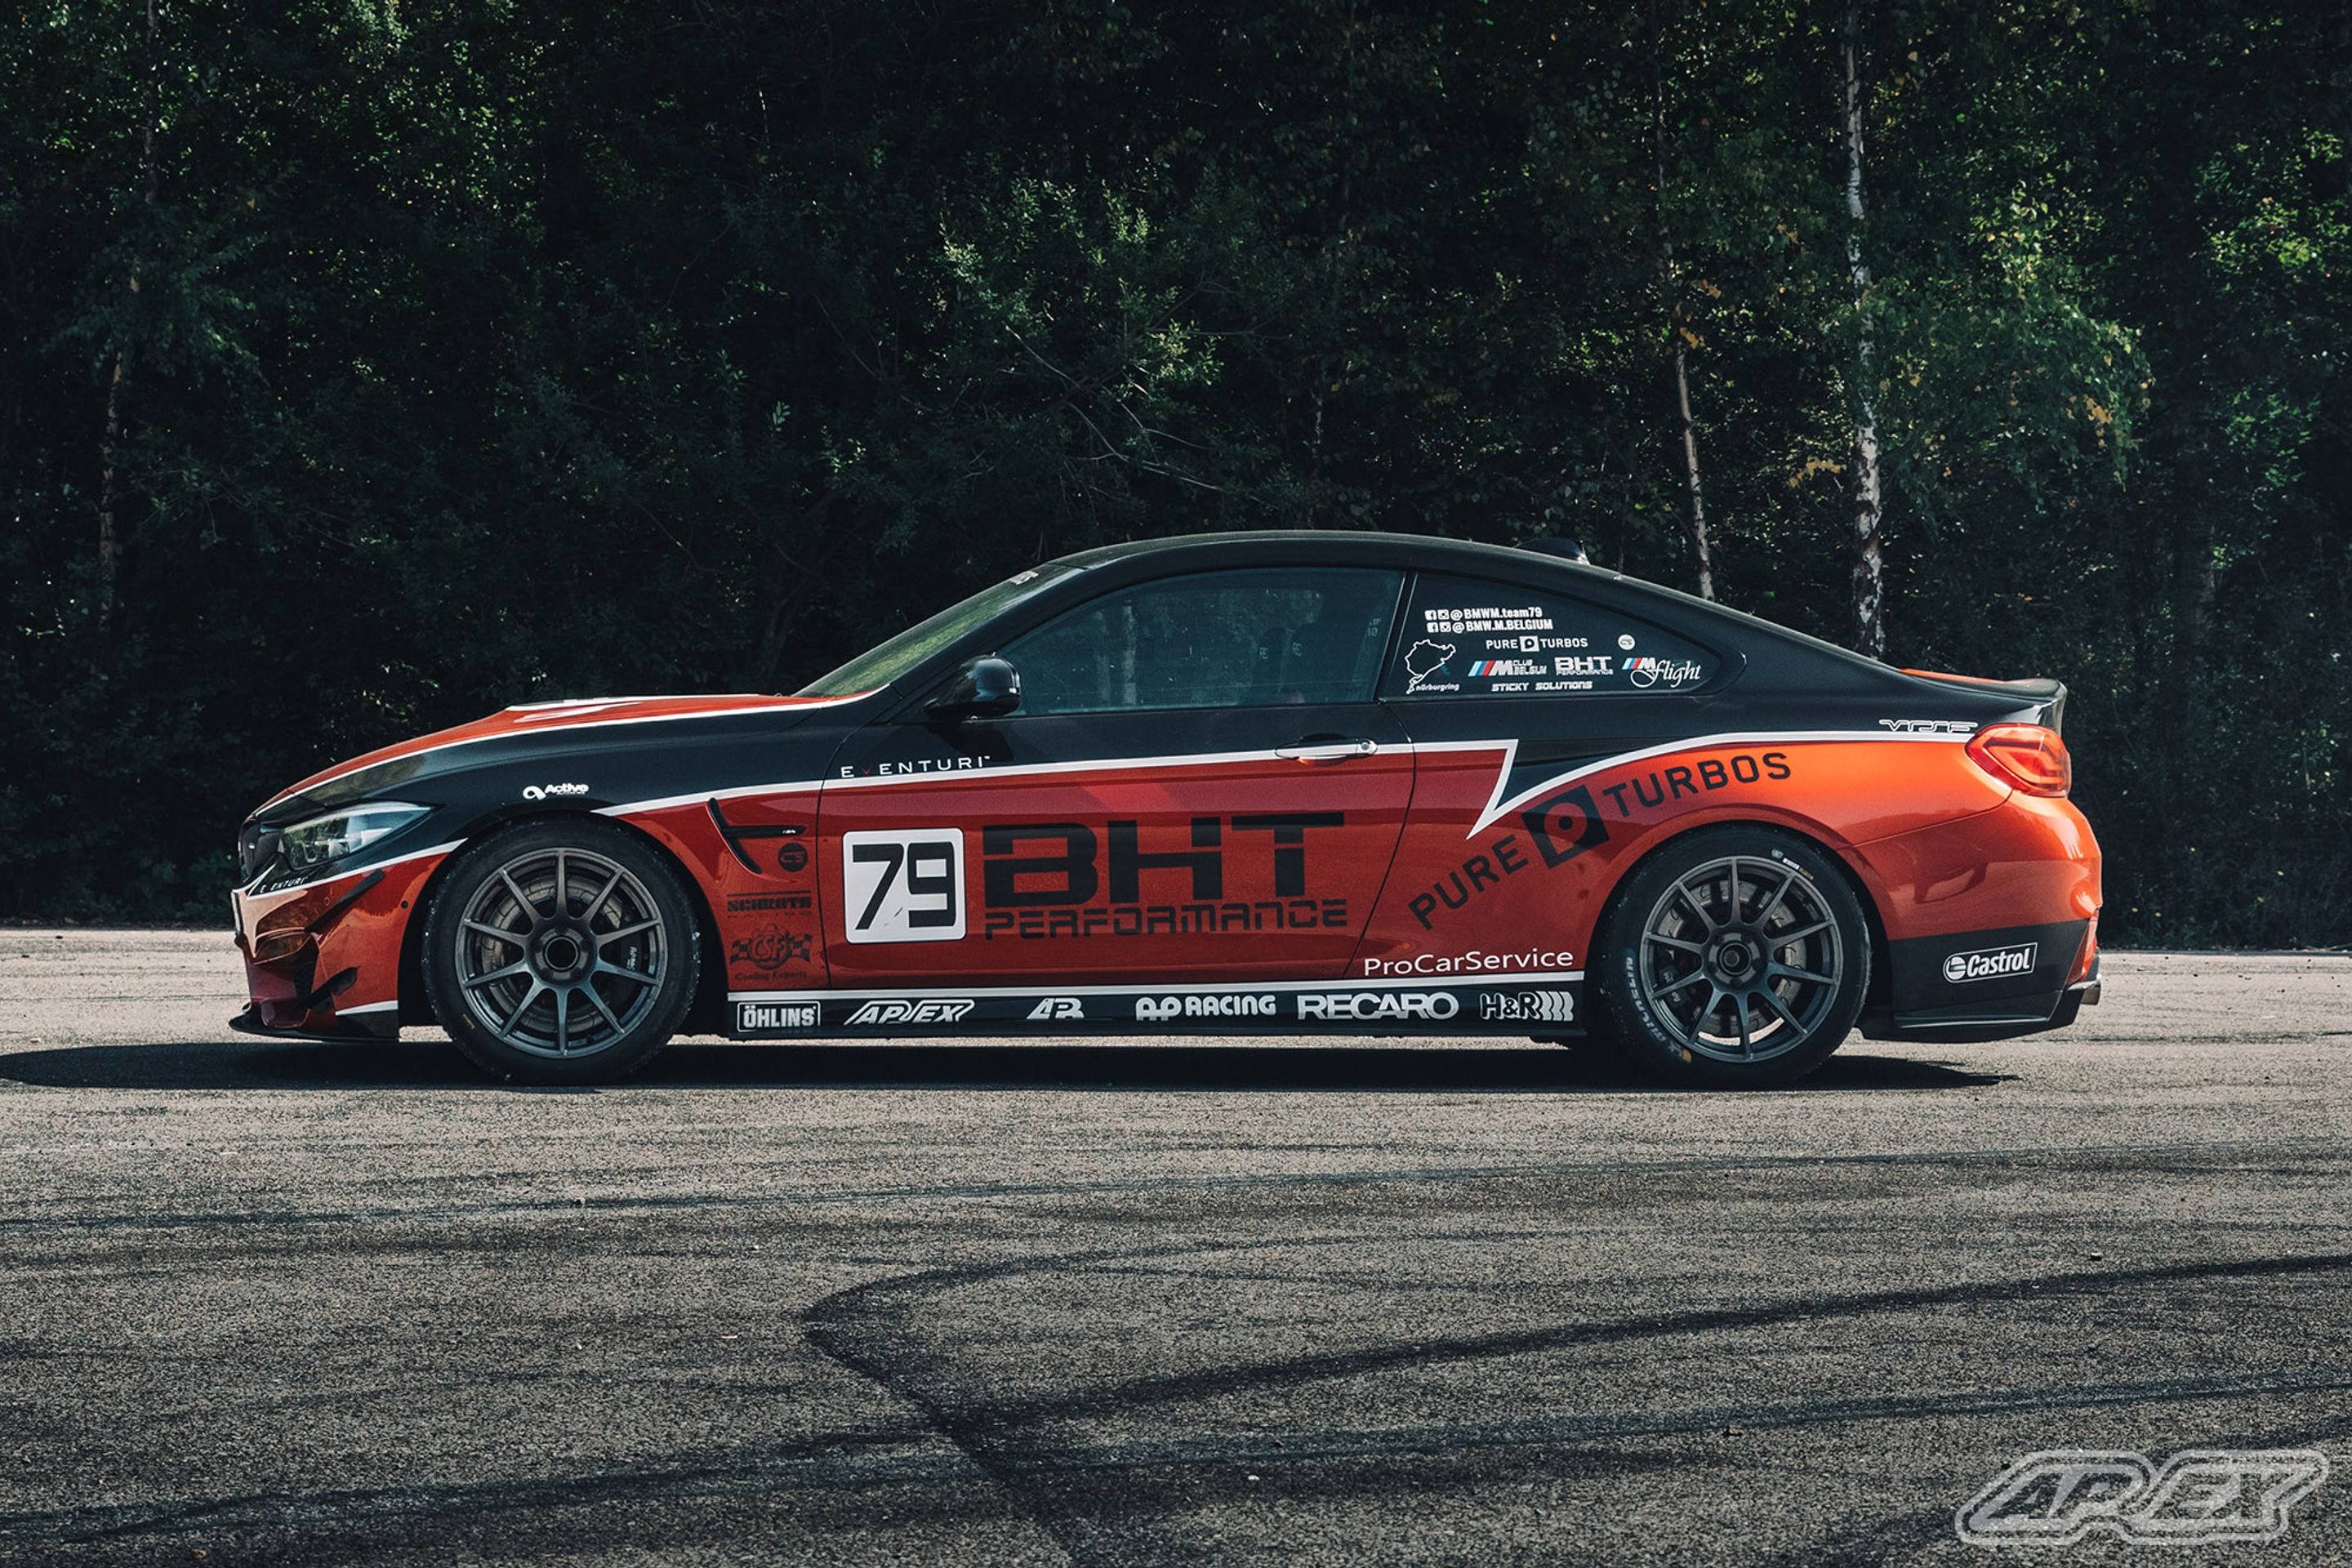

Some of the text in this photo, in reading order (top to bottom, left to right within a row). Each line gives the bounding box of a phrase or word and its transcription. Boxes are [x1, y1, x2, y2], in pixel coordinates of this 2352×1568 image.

[1486, 638, 1588, 649] PURE TURBOS
[1554, 657, 1612, 670] BHT
[1491, 683, 1529, 692] STICKY
[1603, 752, 1791, 817] TURBOS
[982, 812, 1345, 908] BHT
[852, 841, 957, 930] 79
[1408, 835, 1530, 931] PURE
[985, 899, 1348, 940] PERFORMANCE
[1364, 948, 1574, 976] ProCarService
[1967, 947, 2030, 977] Castrol
[743, 1004, 815, 1028] ÖHLINS
[846, 1000, 973, 1025] APEX
[1135, 995, 1276, 1021] AP RACING
[1297, 991, 1459, 1020] RECARO
[1480, 991, 1543, 1020] H&R
